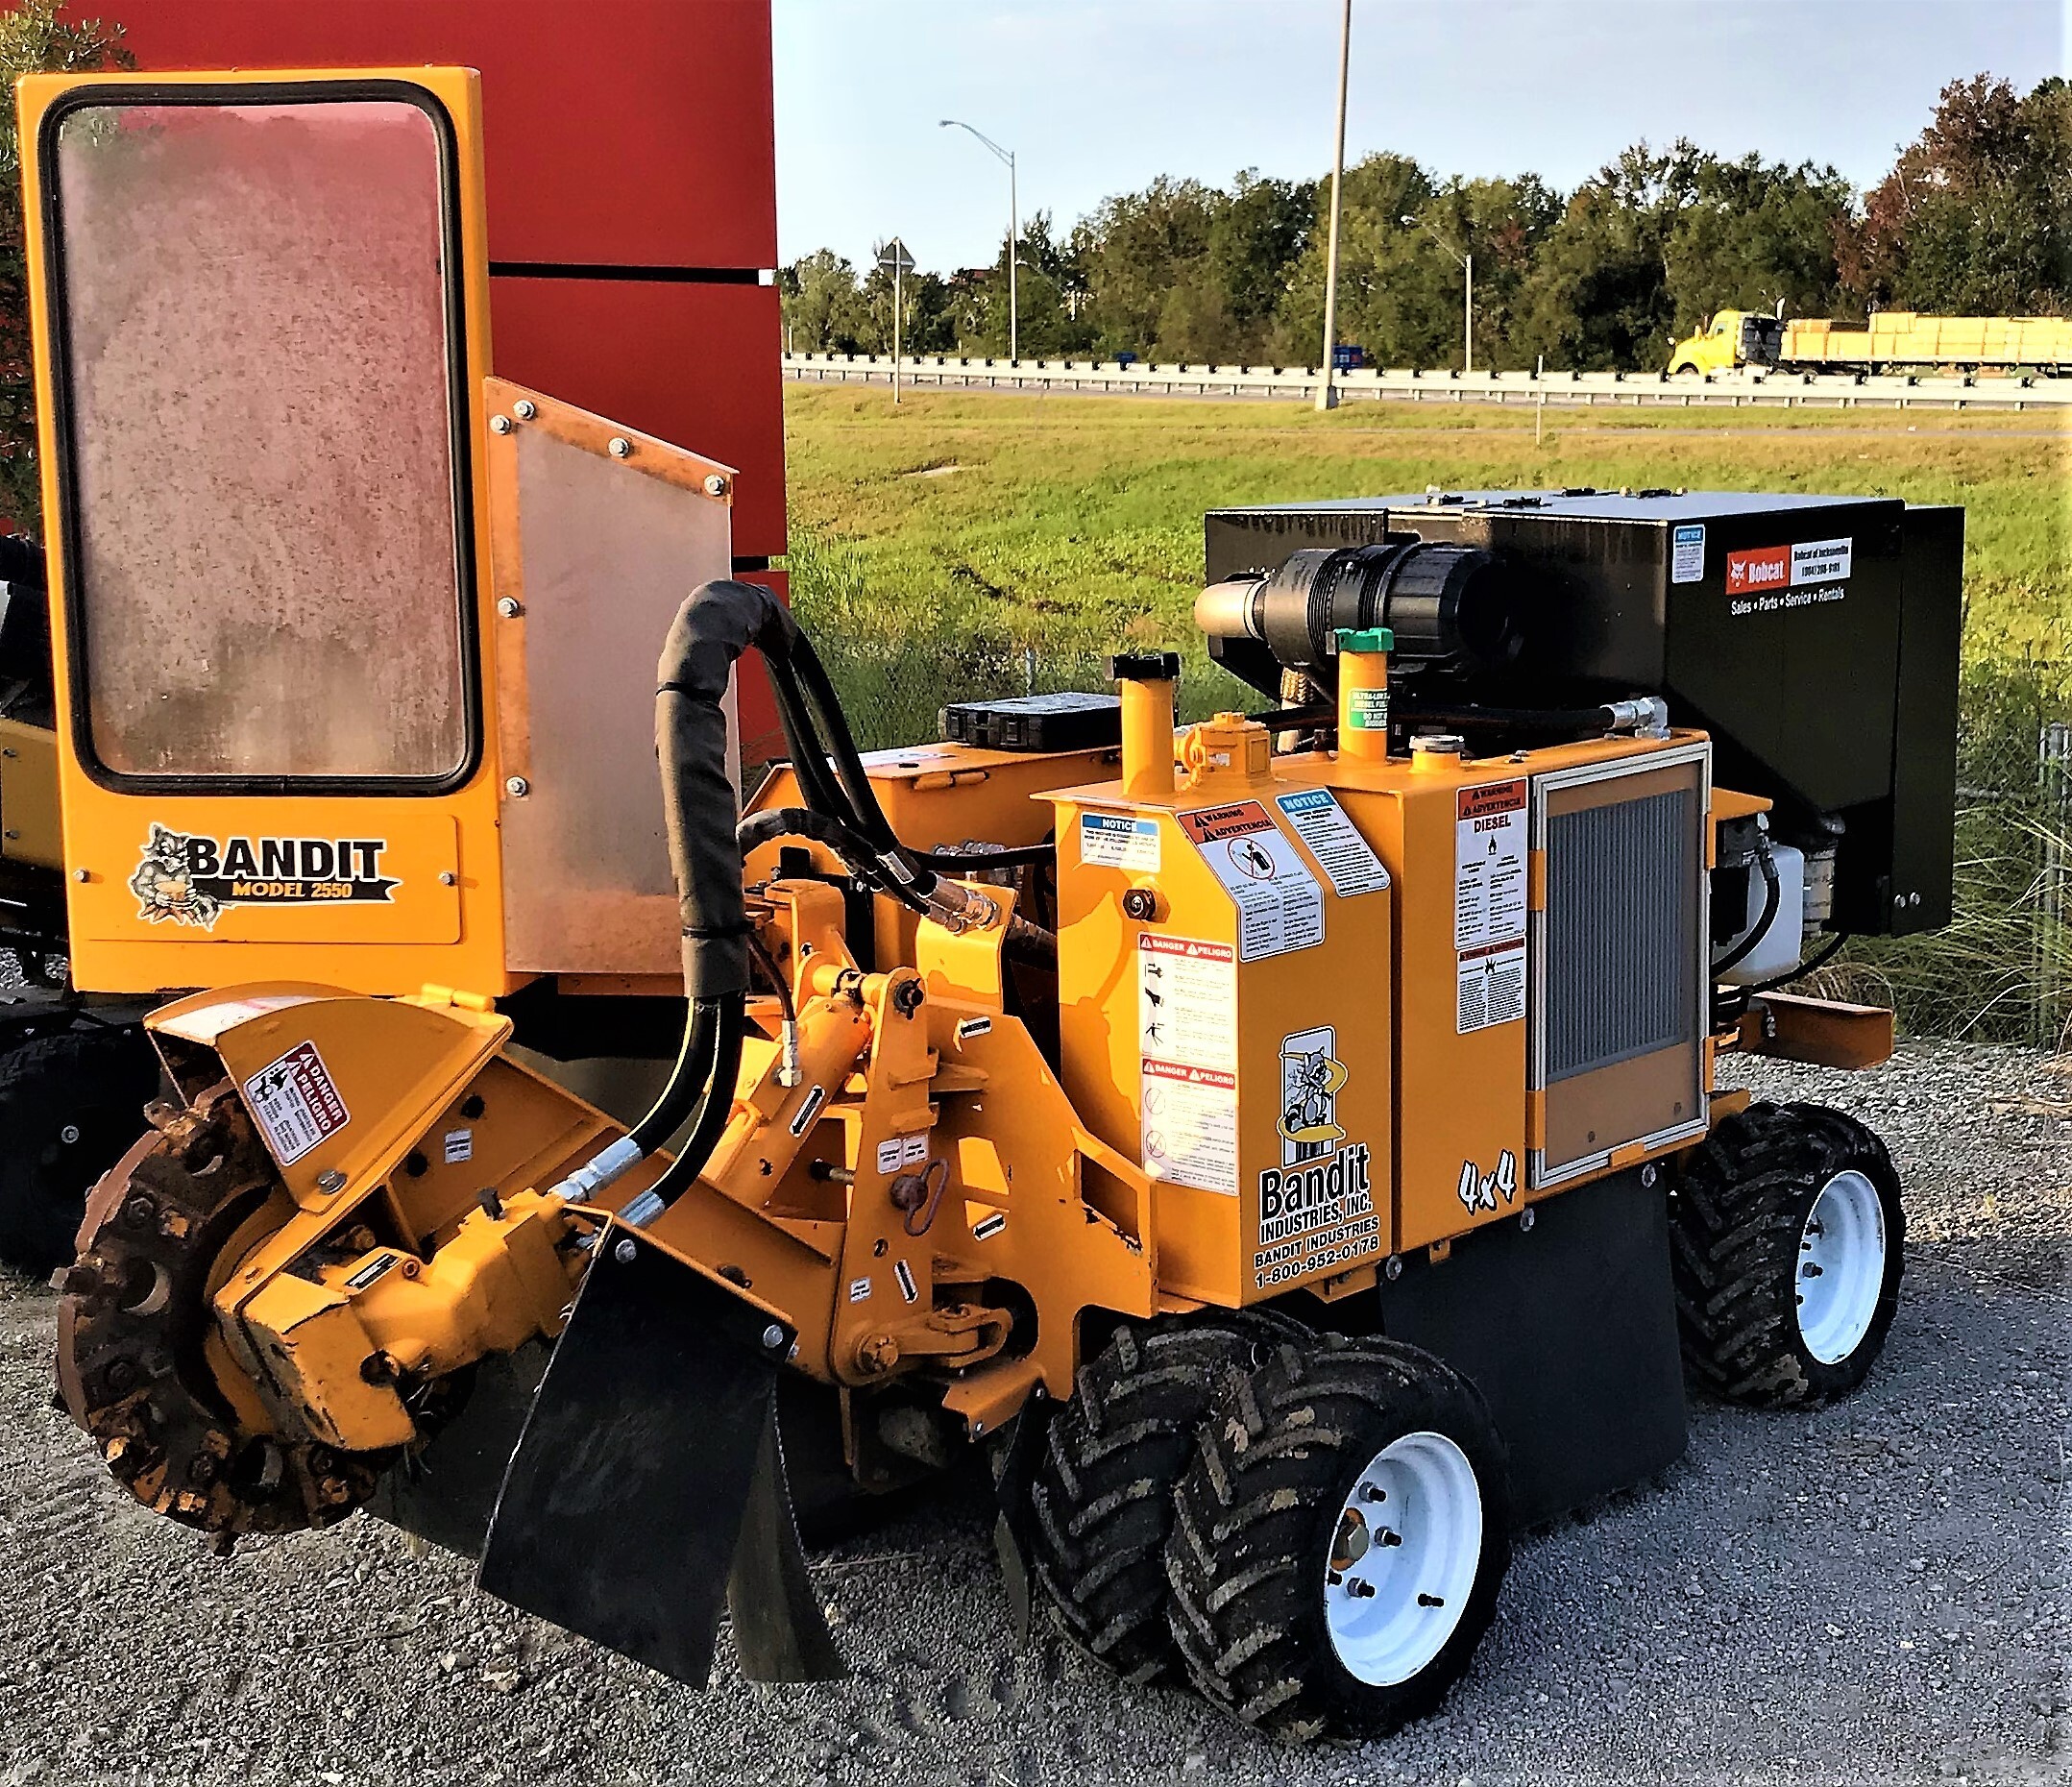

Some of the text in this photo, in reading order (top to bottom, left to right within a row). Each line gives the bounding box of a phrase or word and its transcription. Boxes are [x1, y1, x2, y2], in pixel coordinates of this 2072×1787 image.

[1748, 560, 1785, 584] Bobcat
[1731, 586, 1844, 616] Sales Parts Service Rentals
[1205, 808, 1245, 821] WARNING
[1283, 794, 1329, 810] NOTICE
[1102, 819, 1137, 832] NOTICE
[1474, 814, 1512, 833] DIESEL
[189, 838, 384, 880] BANDIT
[232, 881, 353, 898] MODEL 2550
[1153, 940, 1232, 959] DANGER PELIGRO
[1155, 1064, 1234, 1086] DANGER PELIGRO
[297, 1072, 331, 1131] PELIGRO
[309, 1065, 343, 1121] DANGER
[1260, 1144, 1370, 1221] Bandit
[1259, 1193, 1373, 1245] INDUSTRIES, INC.
[1255, 1216, 1379, 1268] BANDIT INDUSTRIES
[1255, 1236, 1379, 1289] 1-800-952-0178
